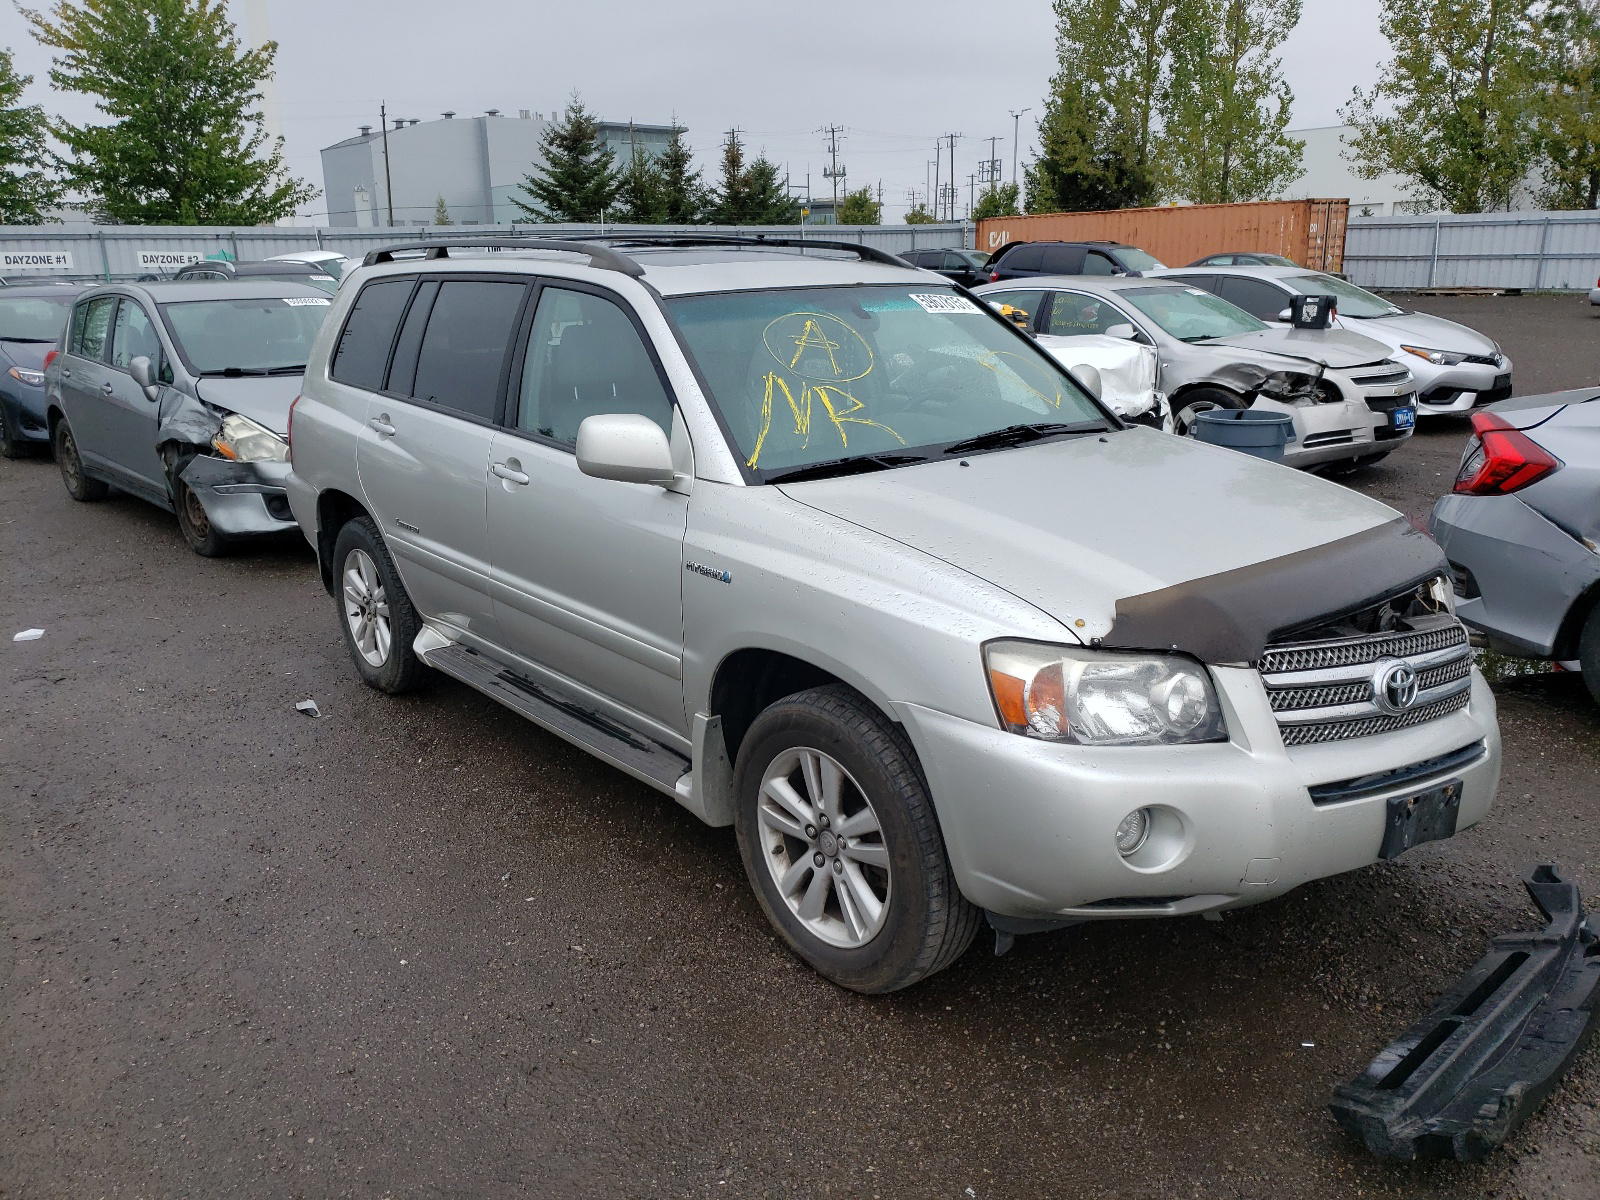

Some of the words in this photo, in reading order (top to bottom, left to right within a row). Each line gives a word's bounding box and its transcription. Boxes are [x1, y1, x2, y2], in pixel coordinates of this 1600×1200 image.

[5, 255, 53, 264] DAYZONE
[56, 255, 67, 264] #1
[142, 255, 185, 263] DAYZONE
[787, 318, 842, 376] A
[745, 372, 908, 470] NR
